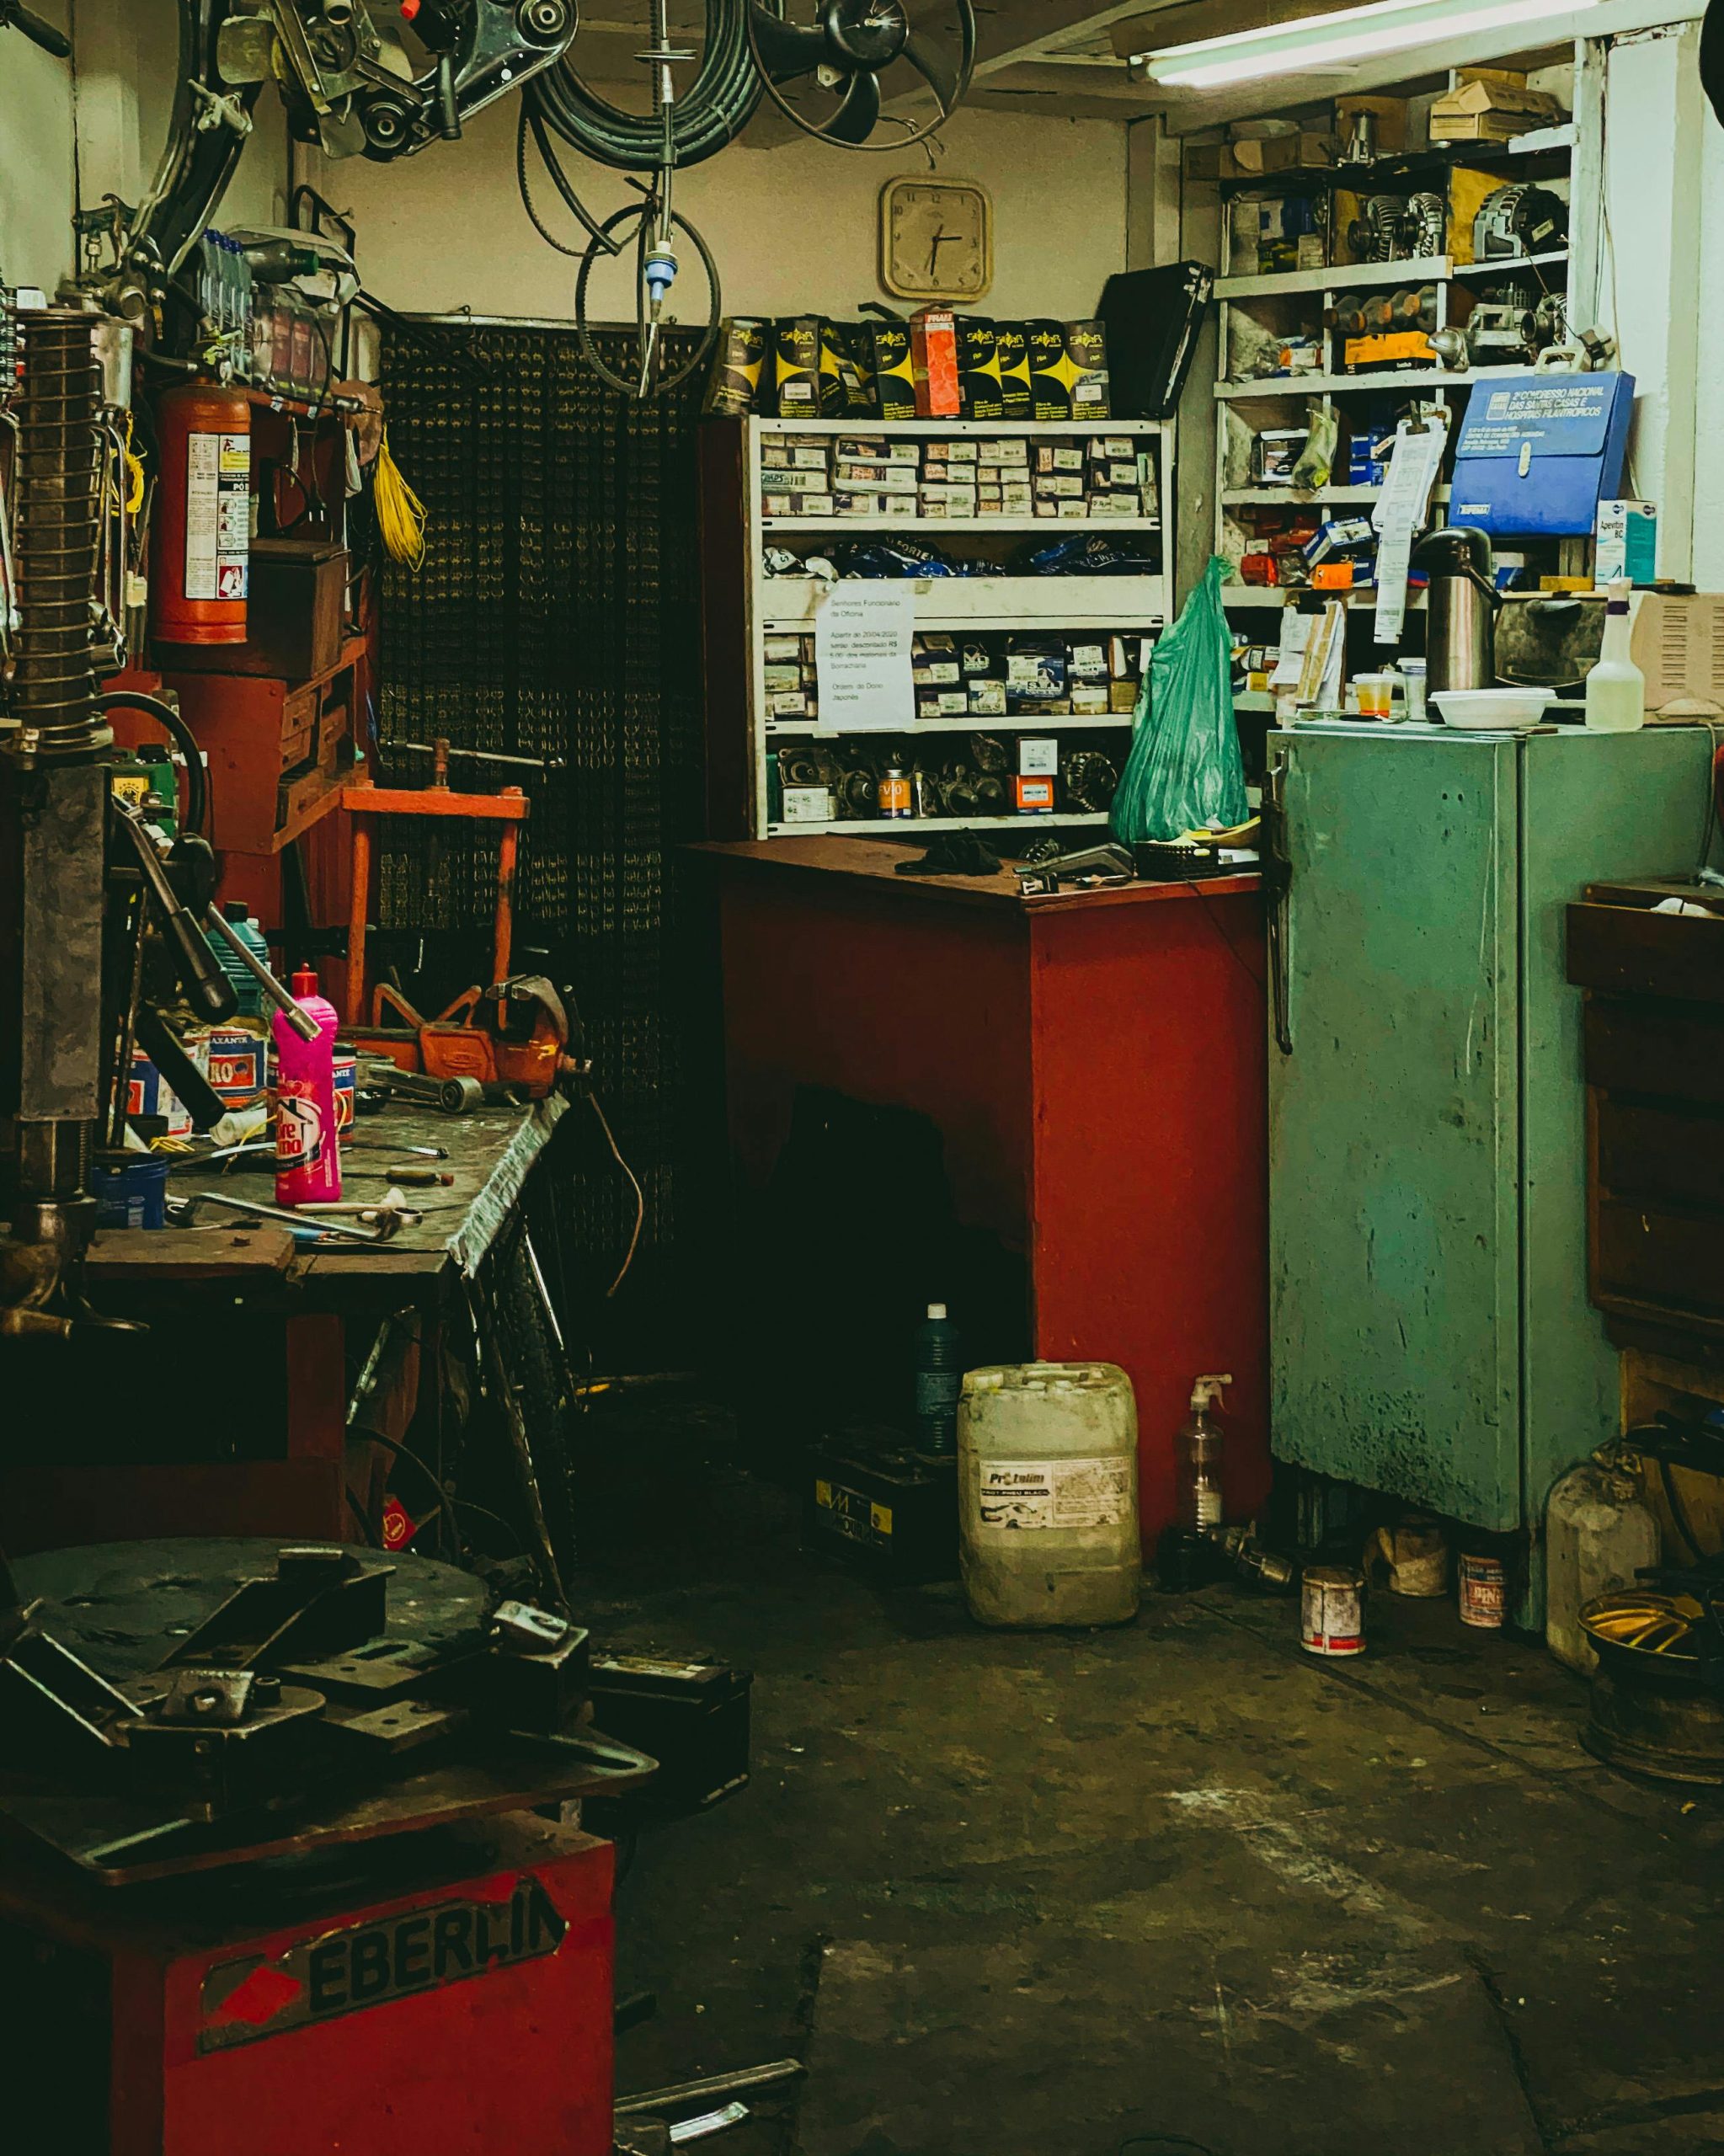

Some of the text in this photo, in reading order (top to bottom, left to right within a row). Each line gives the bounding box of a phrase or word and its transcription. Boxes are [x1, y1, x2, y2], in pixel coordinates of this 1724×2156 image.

[907, 192, 915, 202] 11
[931, 194, 941, 204] 12
[970, 237, 978, 248] 3
[932, 276, 939, 286] 6
